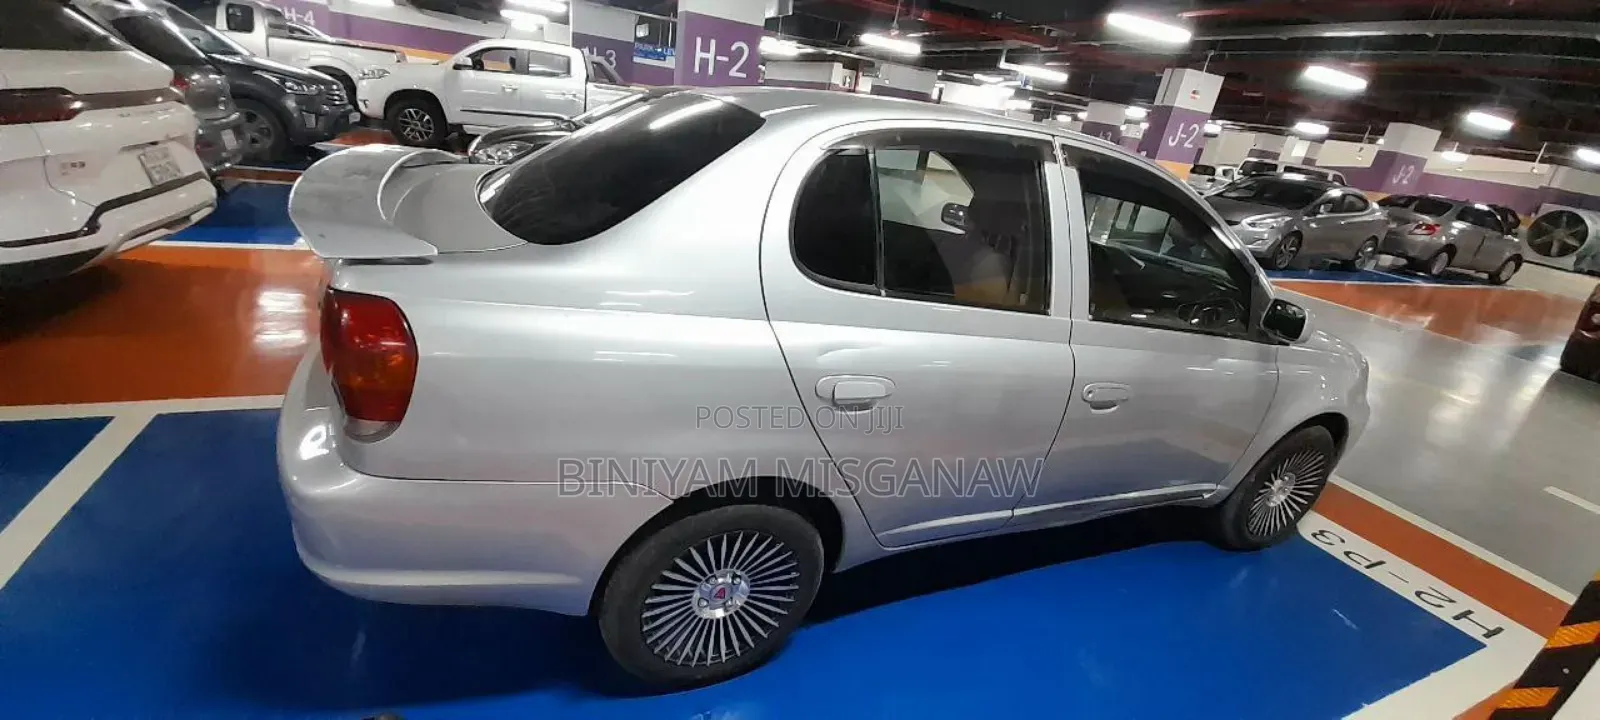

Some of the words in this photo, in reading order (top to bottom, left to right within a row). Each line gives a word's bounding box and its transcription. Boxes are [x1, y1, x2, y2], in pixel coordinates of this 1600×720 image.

[283, 6, 316, 26] H-4
[694, 36, 750, 79] H-2
[1168, 122, 1200, 149] J-2
